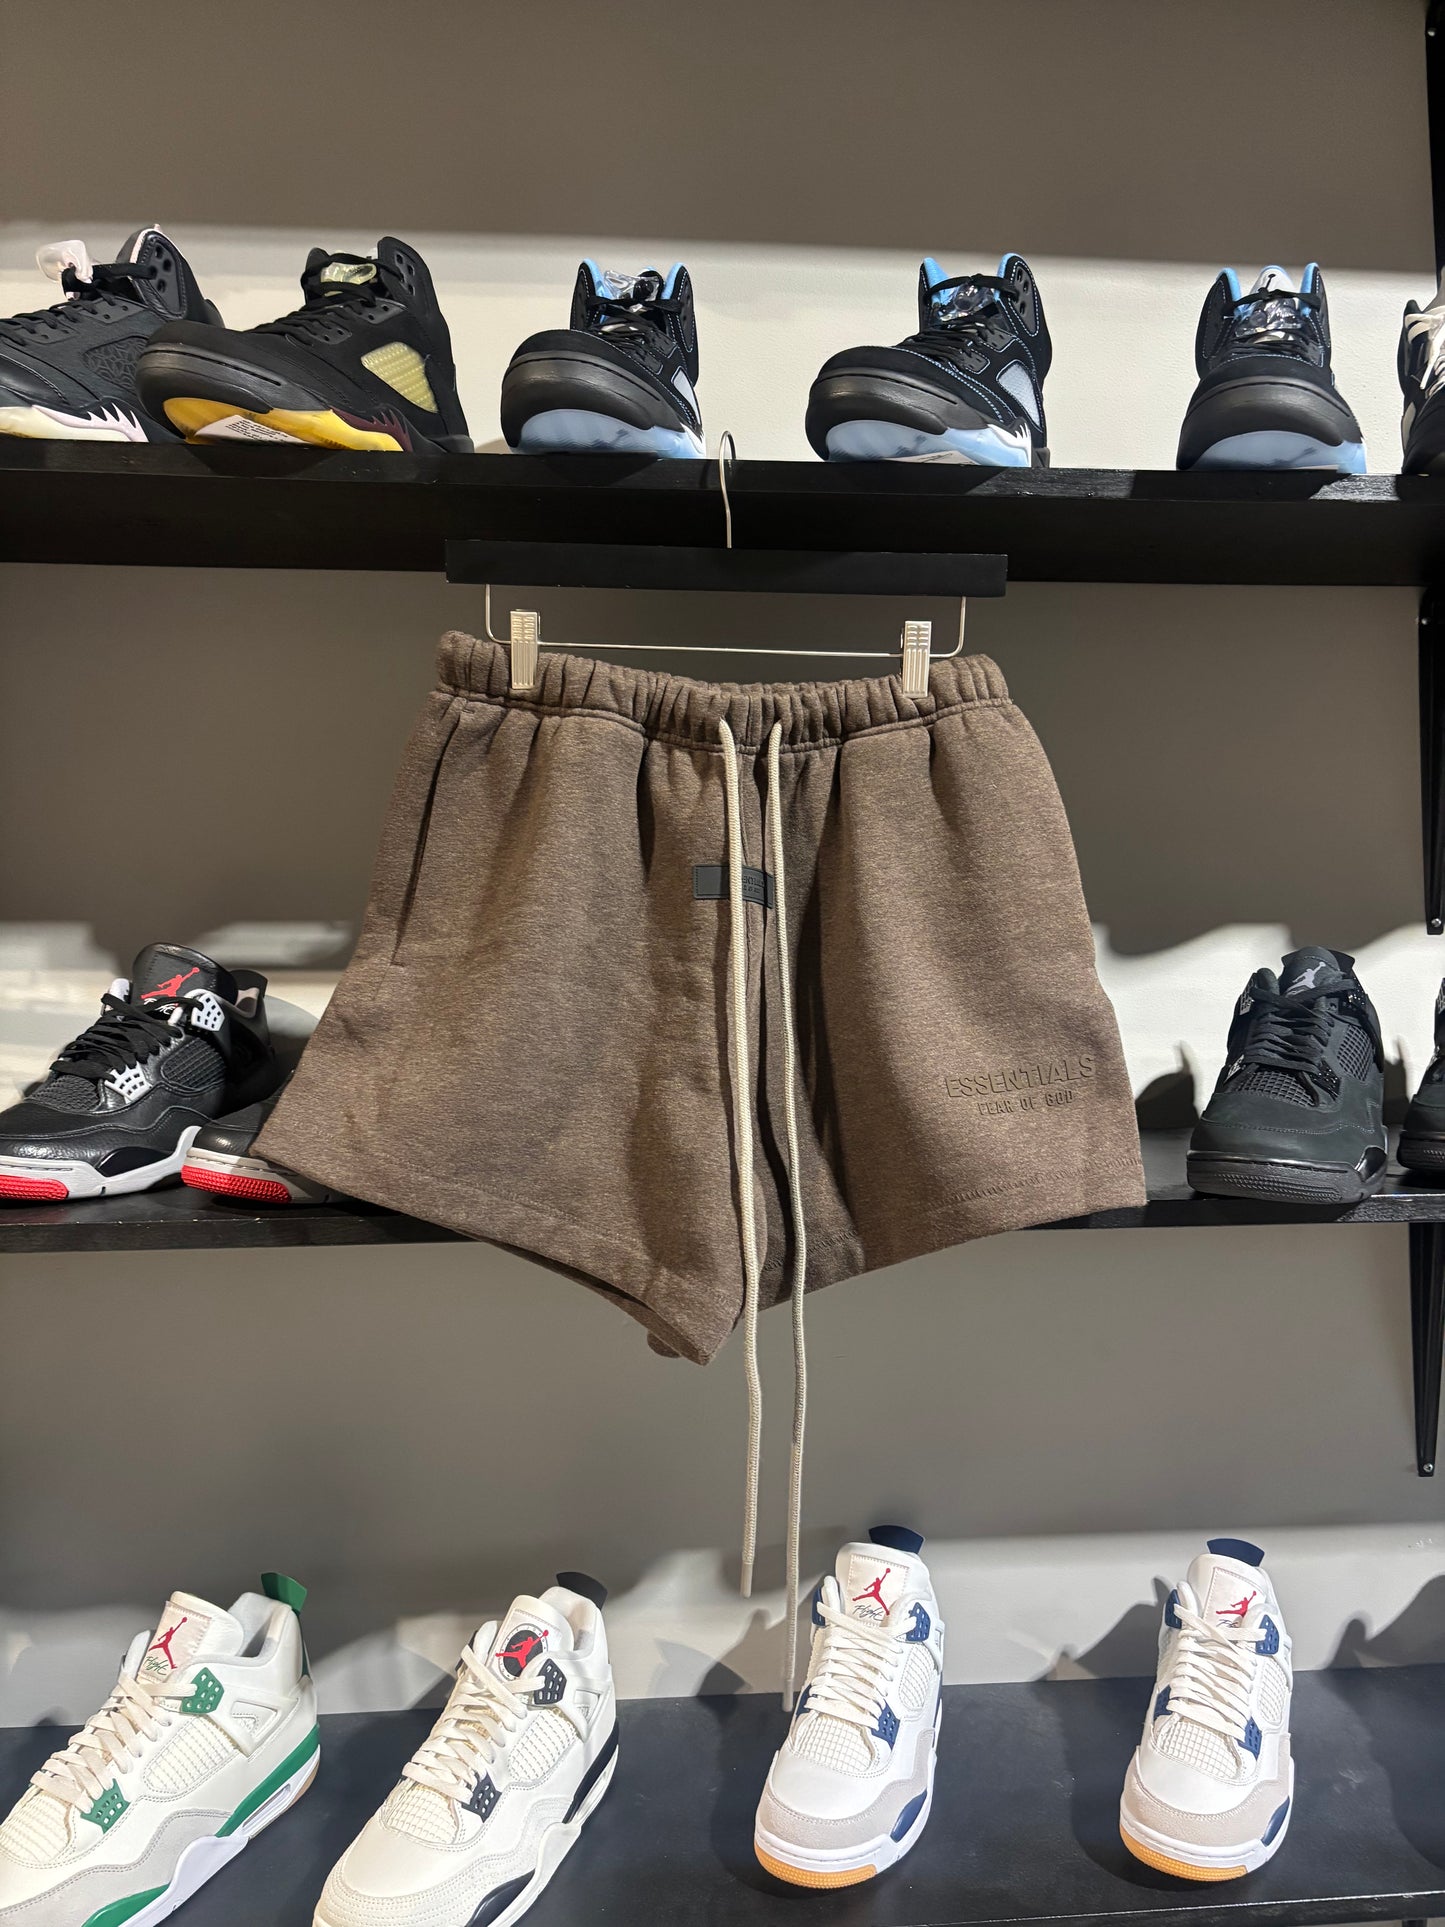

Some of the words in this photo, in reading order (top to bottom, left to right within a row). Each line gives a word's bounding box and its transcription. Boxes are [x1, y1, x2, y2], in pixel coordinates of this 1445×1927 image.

[945, 1054, 1097, 1098] ESSENTIALS
[977, 1099, 1014, 1115] FEAR
[1020, 1096, 1036, 1111] OF
[1044, 1089, 1074, 1106] GOD
